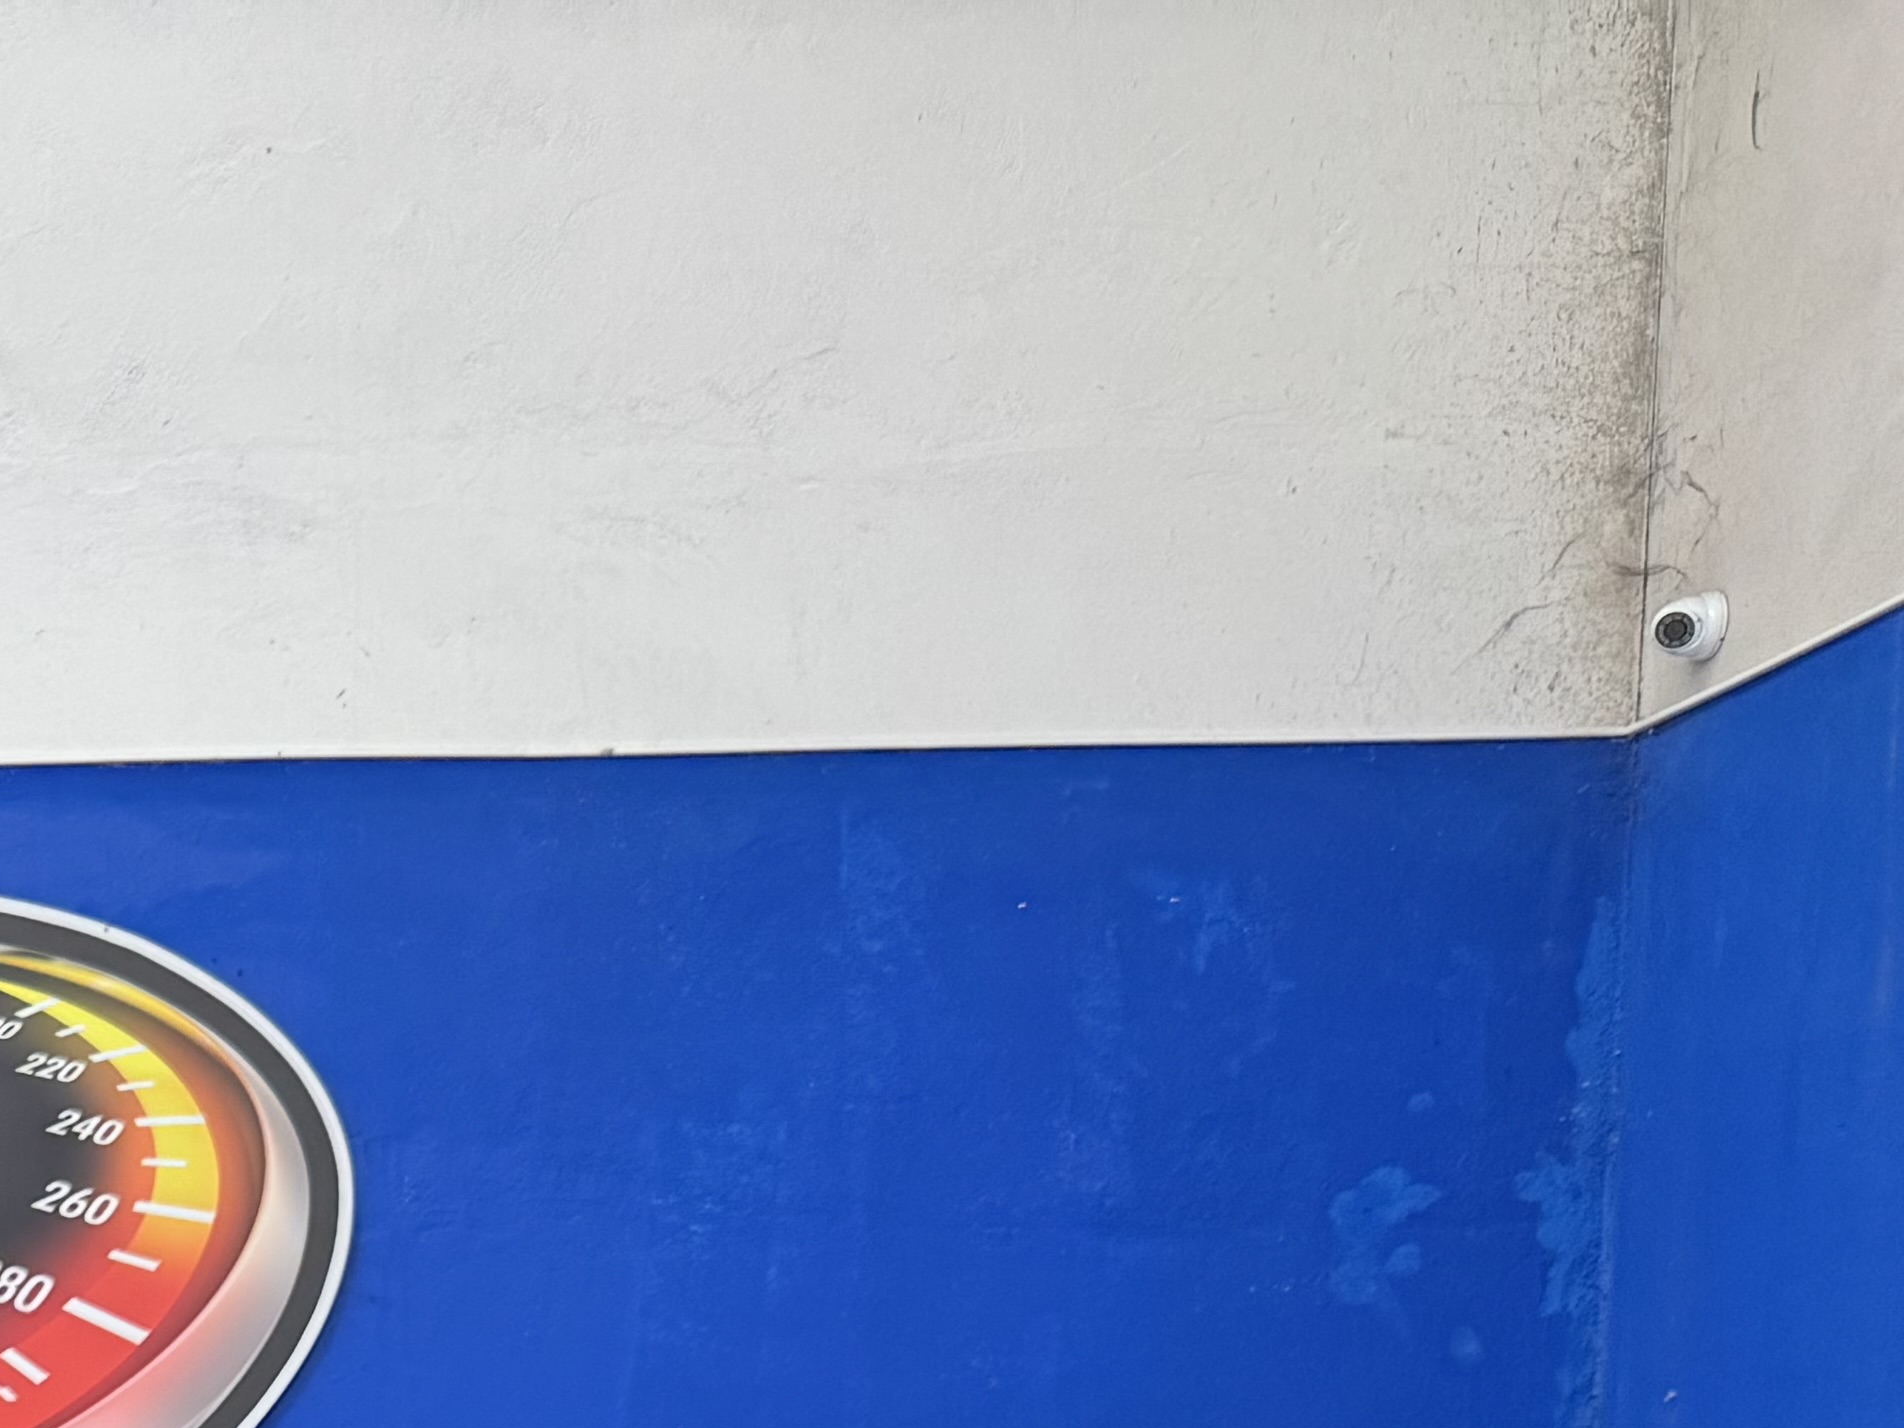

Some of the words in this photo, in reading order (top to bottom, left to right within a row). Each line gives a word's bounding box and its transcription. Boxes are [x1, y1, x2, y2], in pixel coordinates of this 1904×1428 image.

[15, 1052, 86, 1084] 220
[45, 1108, 125, 1146] 240
[30, 1180, 121, 1226] 260
